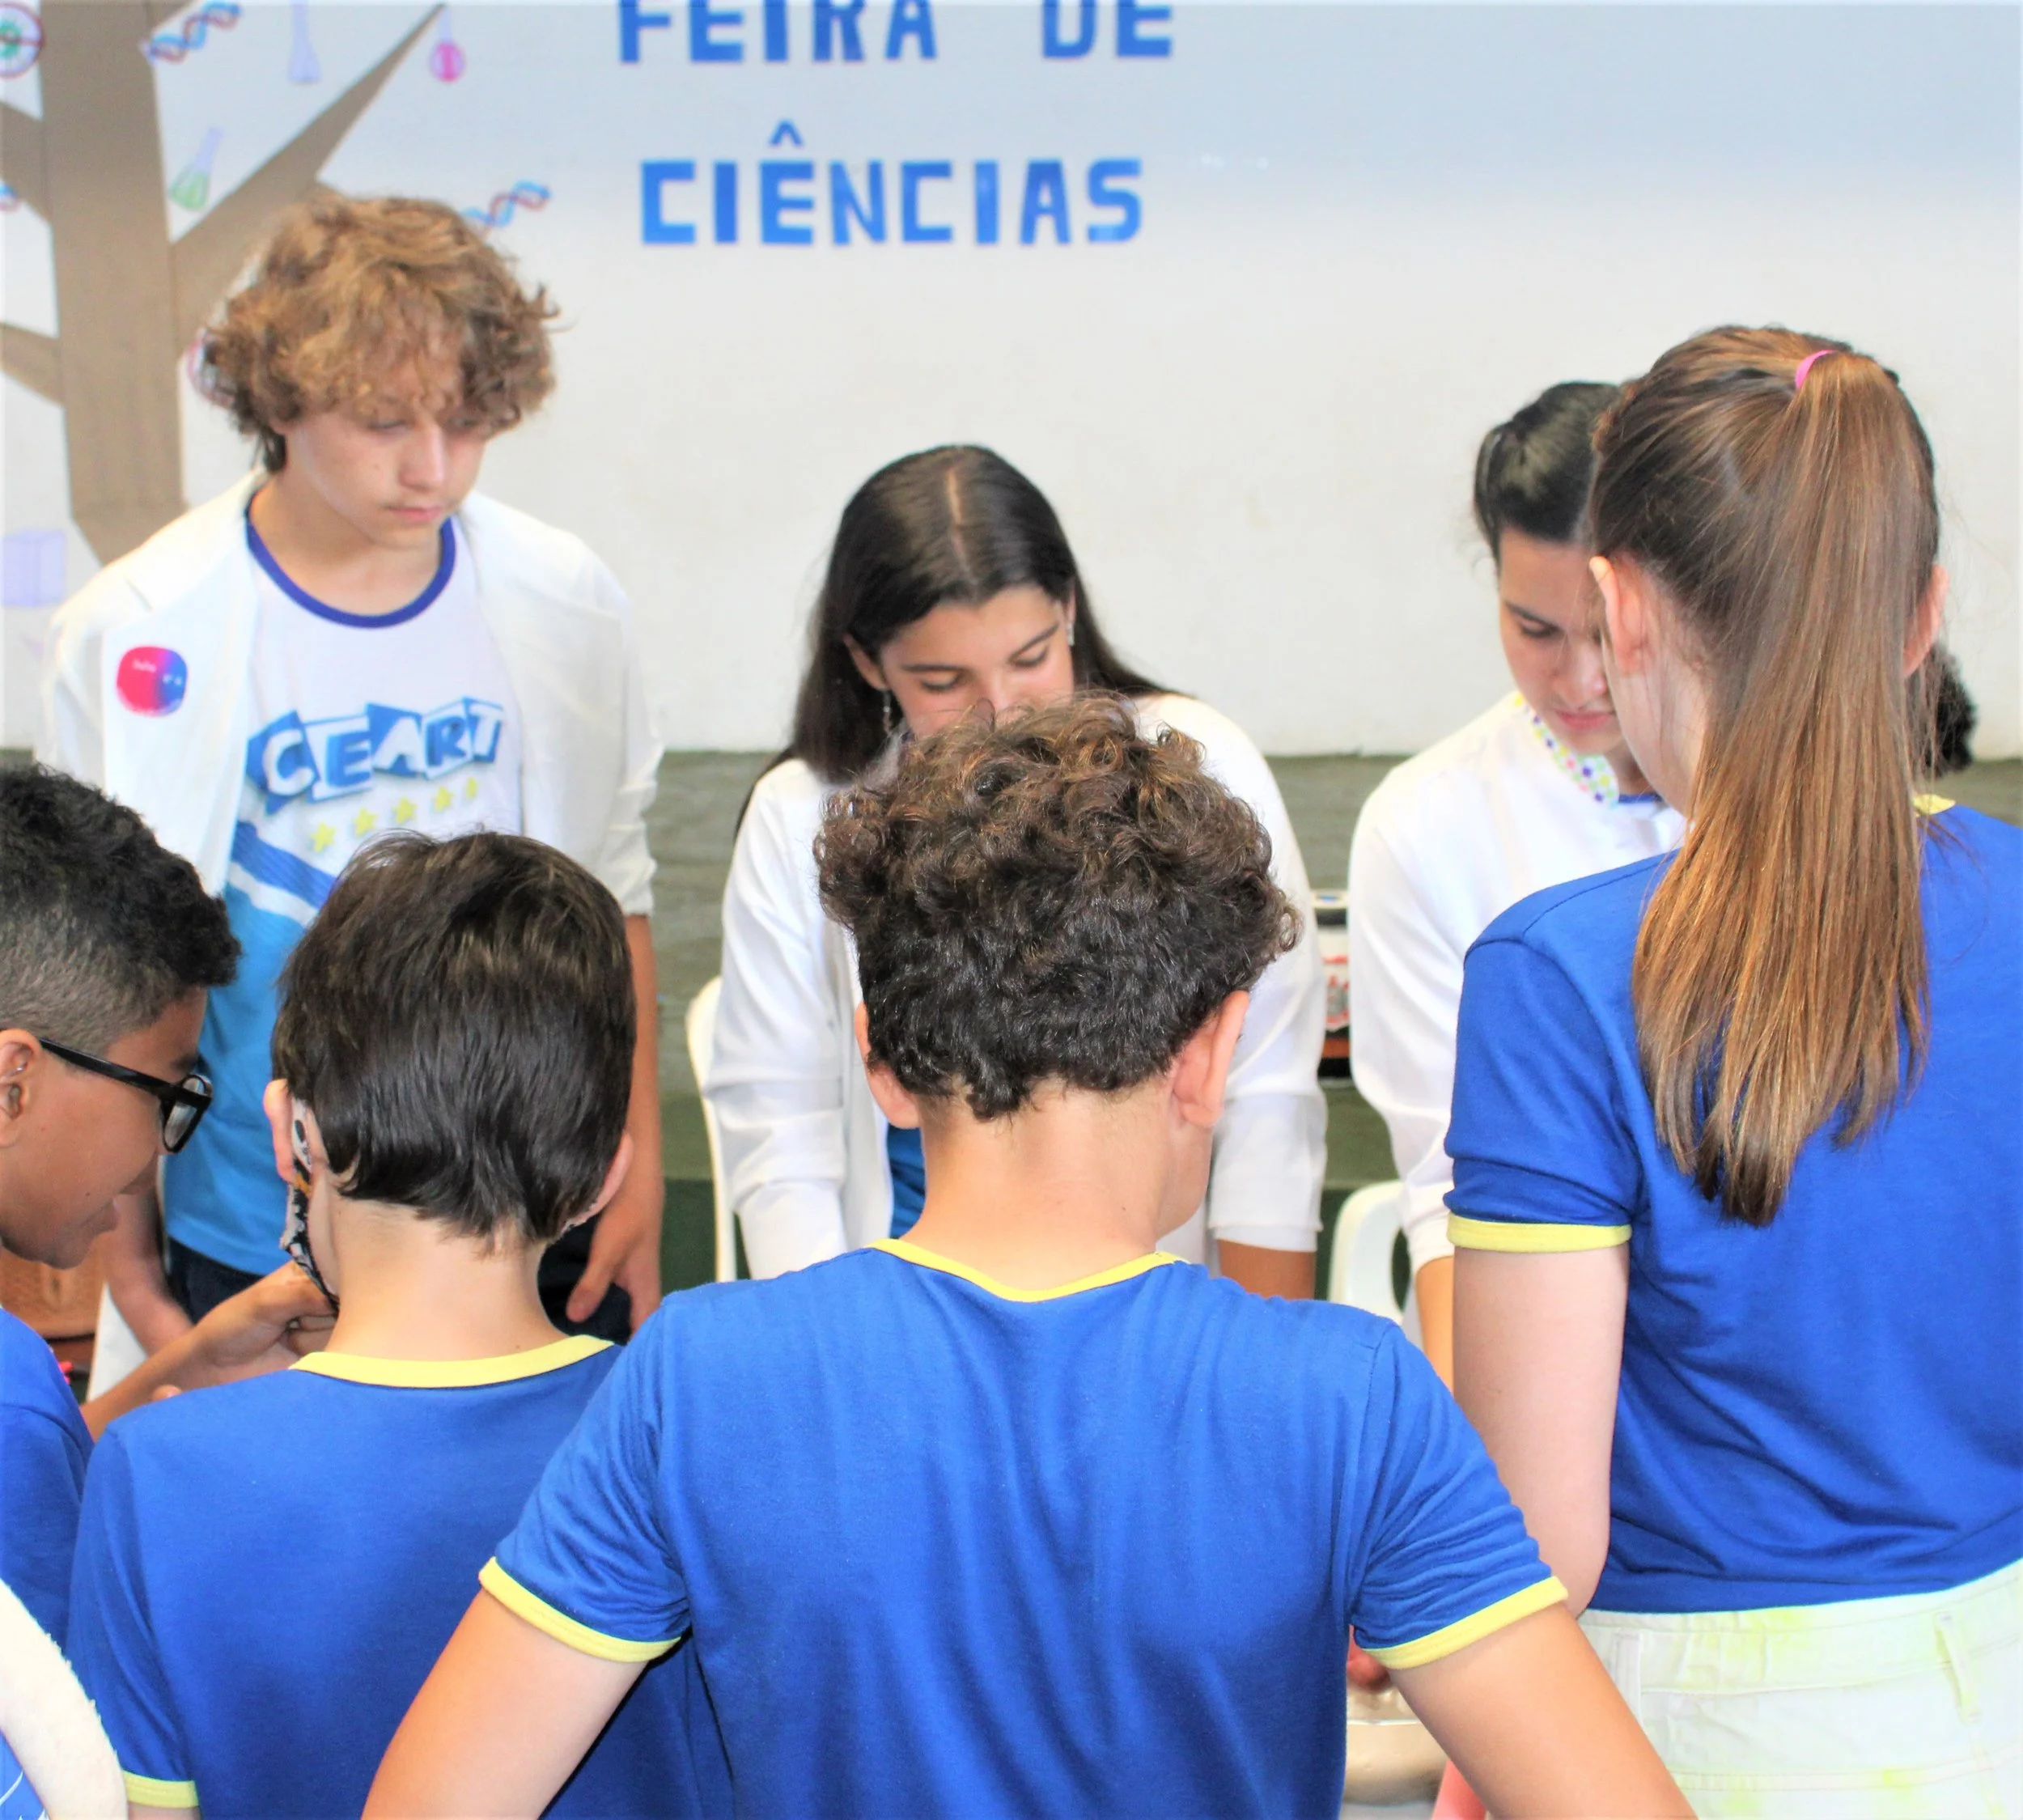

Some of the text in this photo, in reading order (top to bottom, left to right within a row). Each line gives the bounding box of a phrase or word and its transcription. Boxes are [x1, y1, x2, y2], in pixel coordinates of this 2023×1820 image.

[620, 0, 1173, 63] FEIRA DE
[641, 120, 1143, 245] CIÊNCIAS
[252, 696, 503, 801] CEART
